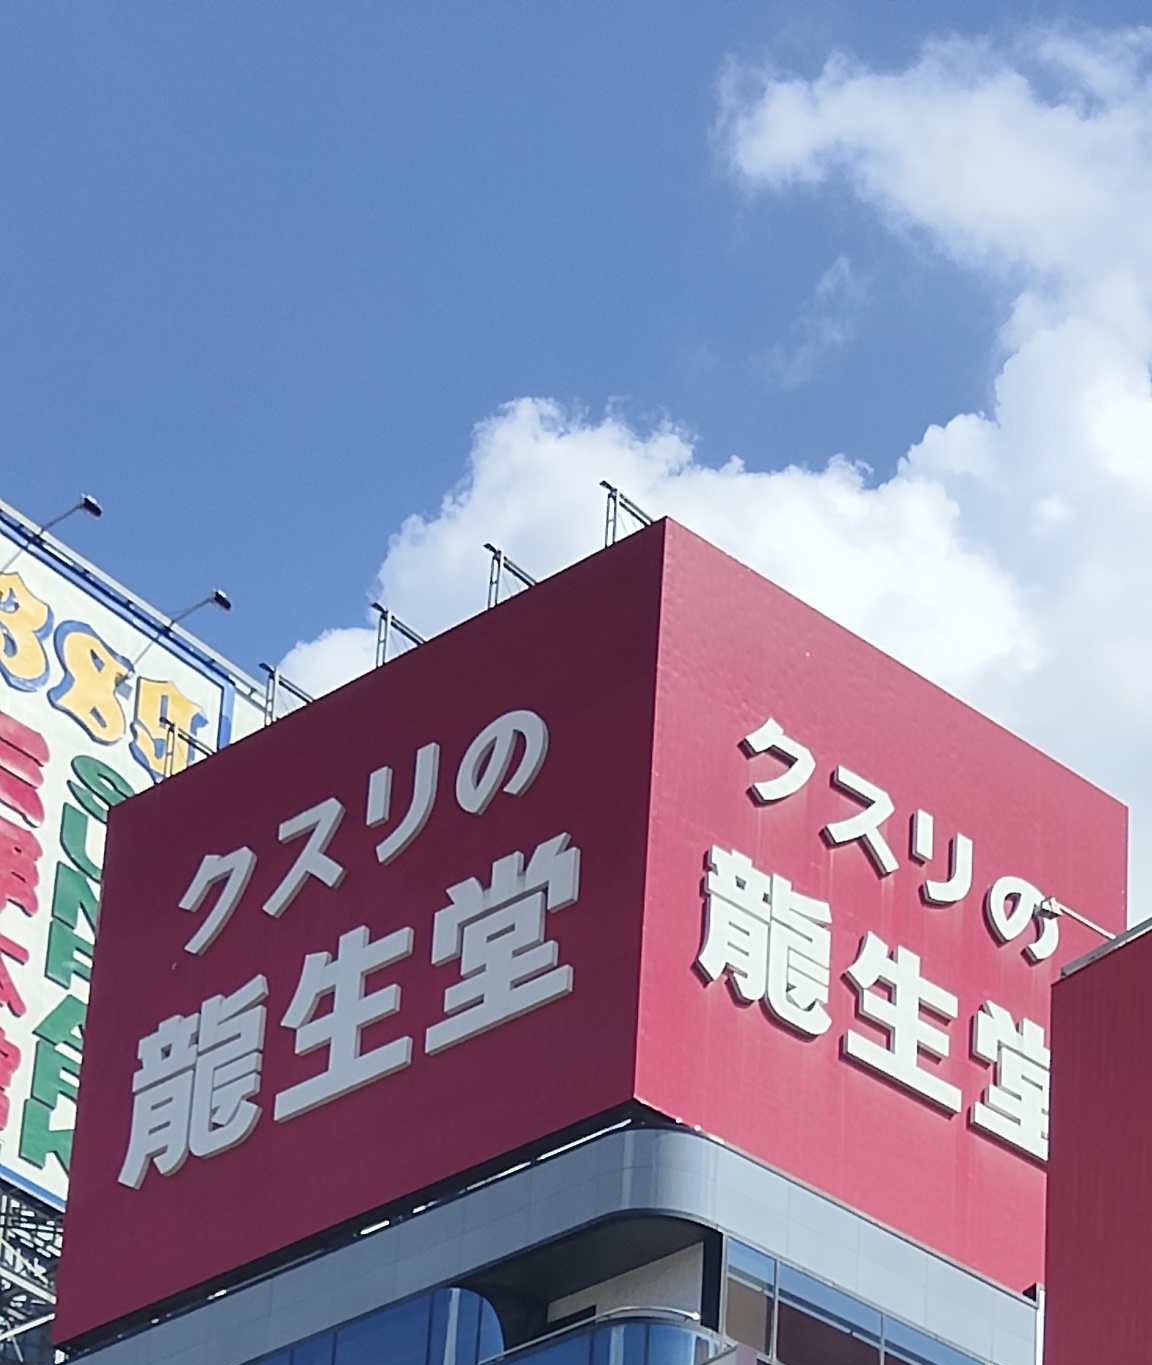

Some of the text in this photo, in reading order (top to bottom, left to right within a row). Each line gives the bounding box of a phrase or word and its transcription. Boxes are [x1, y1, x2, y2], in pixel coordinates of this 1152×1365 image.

[177, 708, 548, 956] クスリの
[740, 717, 1059, 963] クスリの
[117, 832, 582, 1188] 龍生堂
[694, 844, 1050, 1162] 龍生堂
